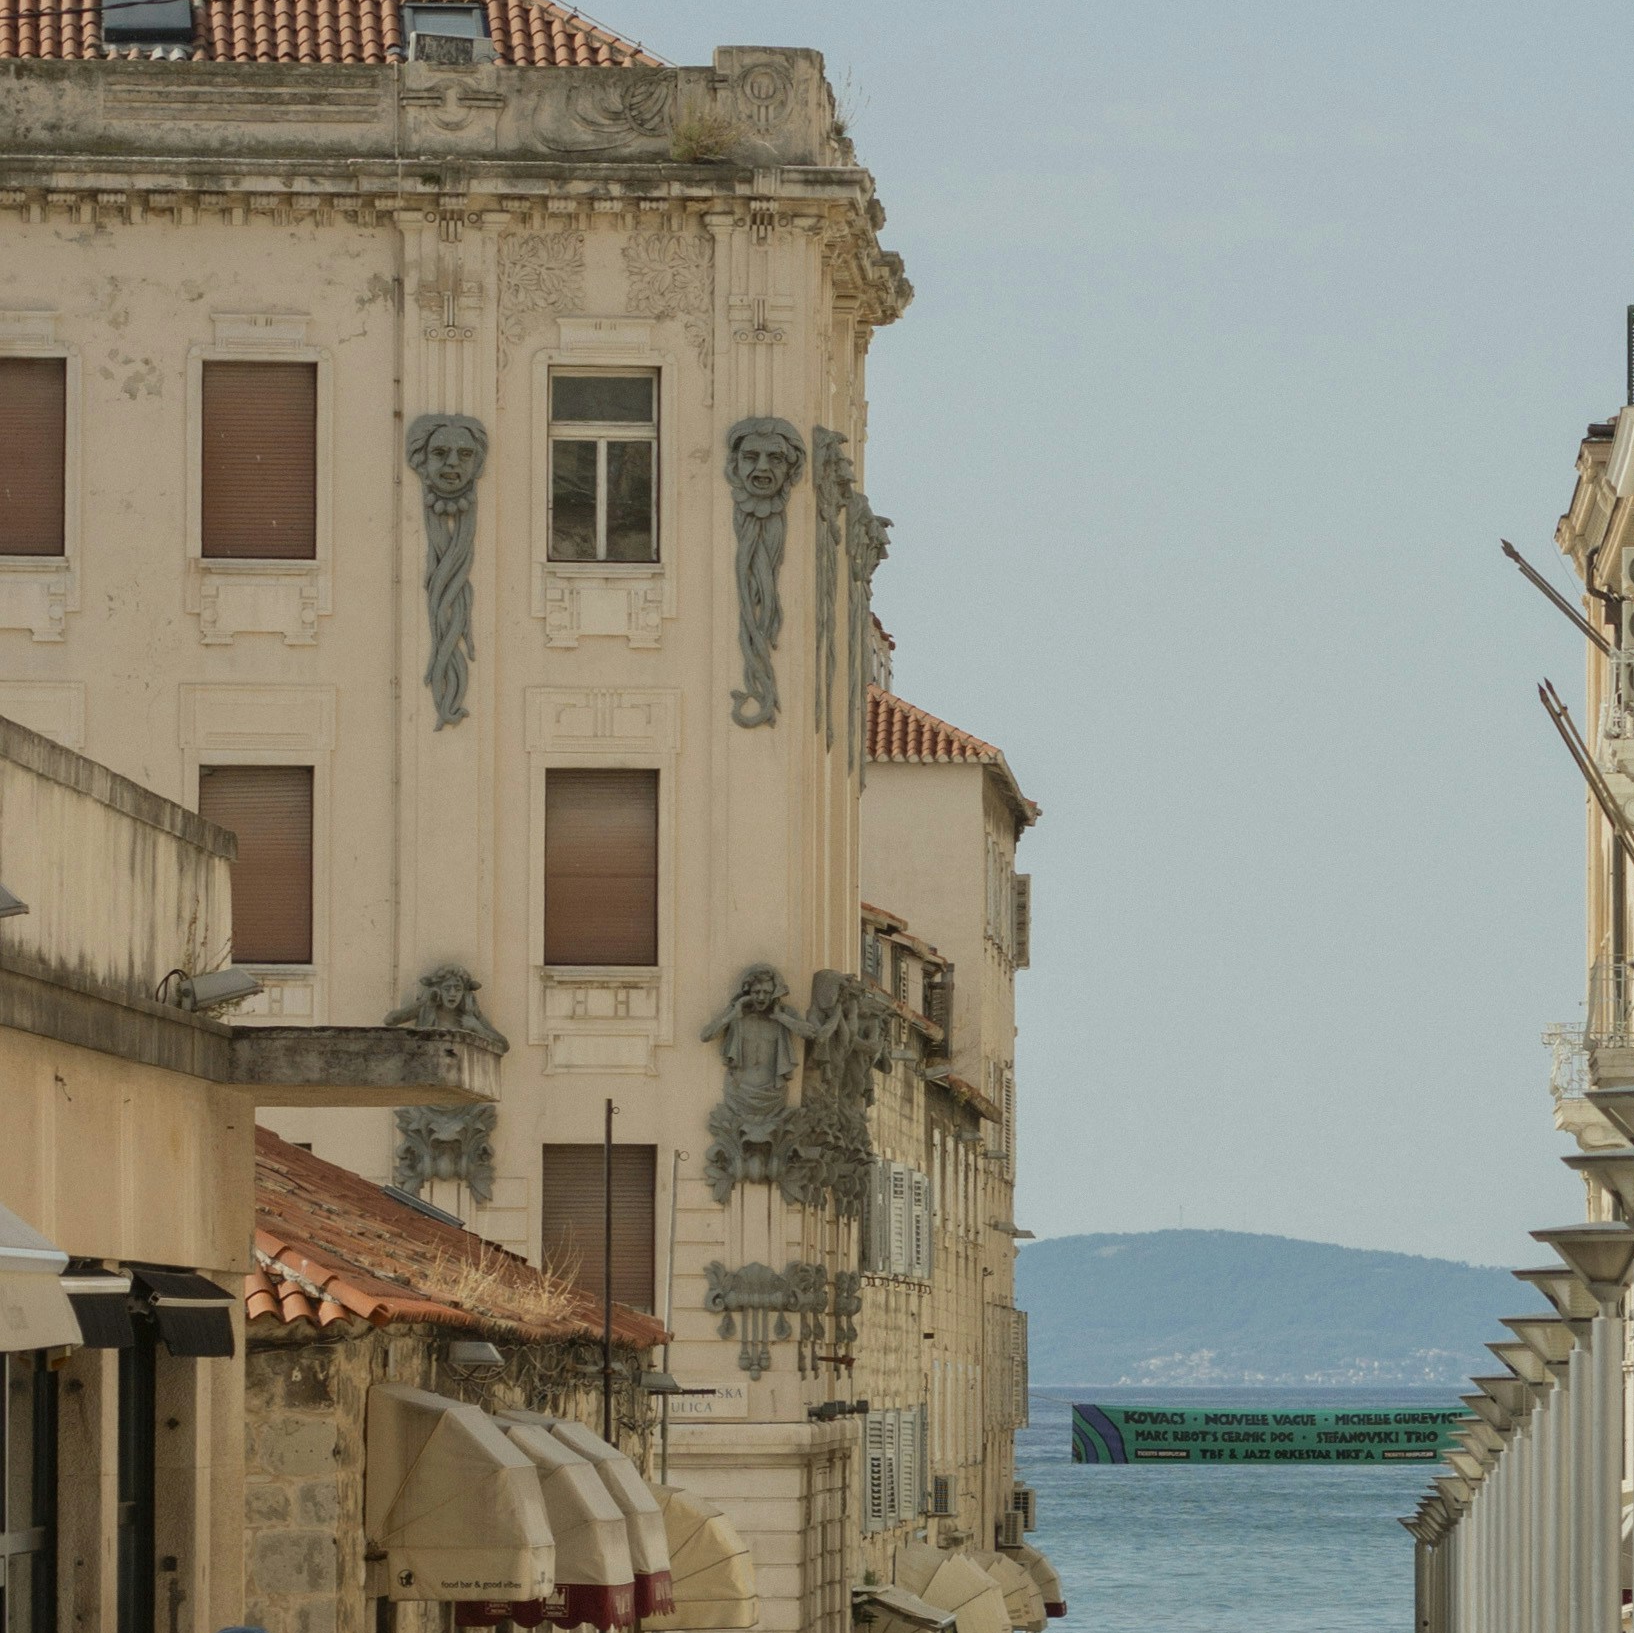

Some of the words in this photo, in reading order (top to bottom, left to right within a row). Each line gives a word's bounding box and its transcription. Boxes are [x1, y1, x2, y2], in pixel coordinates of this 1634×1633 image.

[671, 1402, 712, 1413] ULICA
[1123, 1411, 1185, 1425] KOVACS
[1204, 1413, 1269, 1426] NOUVELLE
[1272, 1414, 1317, 1426] VAGUE
[1335, 1413, 1392, 1426] MICHELLE
[1135, 1430, 1168, 1442] MARC
[1316, 1430, 1399, 1444] STEFANOVSKI
[1404, 1430, 1438, 1443] TRIO
[1199, 1448, 1224, 1460] TBF
[1229, 1448, 1238, 1460] &
[1242, 1449, 1270, 1460] JAZZ
[1274, 1449, 1332, 1460] ORKESTAR
[441, 1580, 459, 1589] food
[460, 1580, 473, 1589] bar
[474, 1580, 481, 1589] &
[482, 1580, 502, 1590] good
[503, 1580, 522, 1589] vibes
